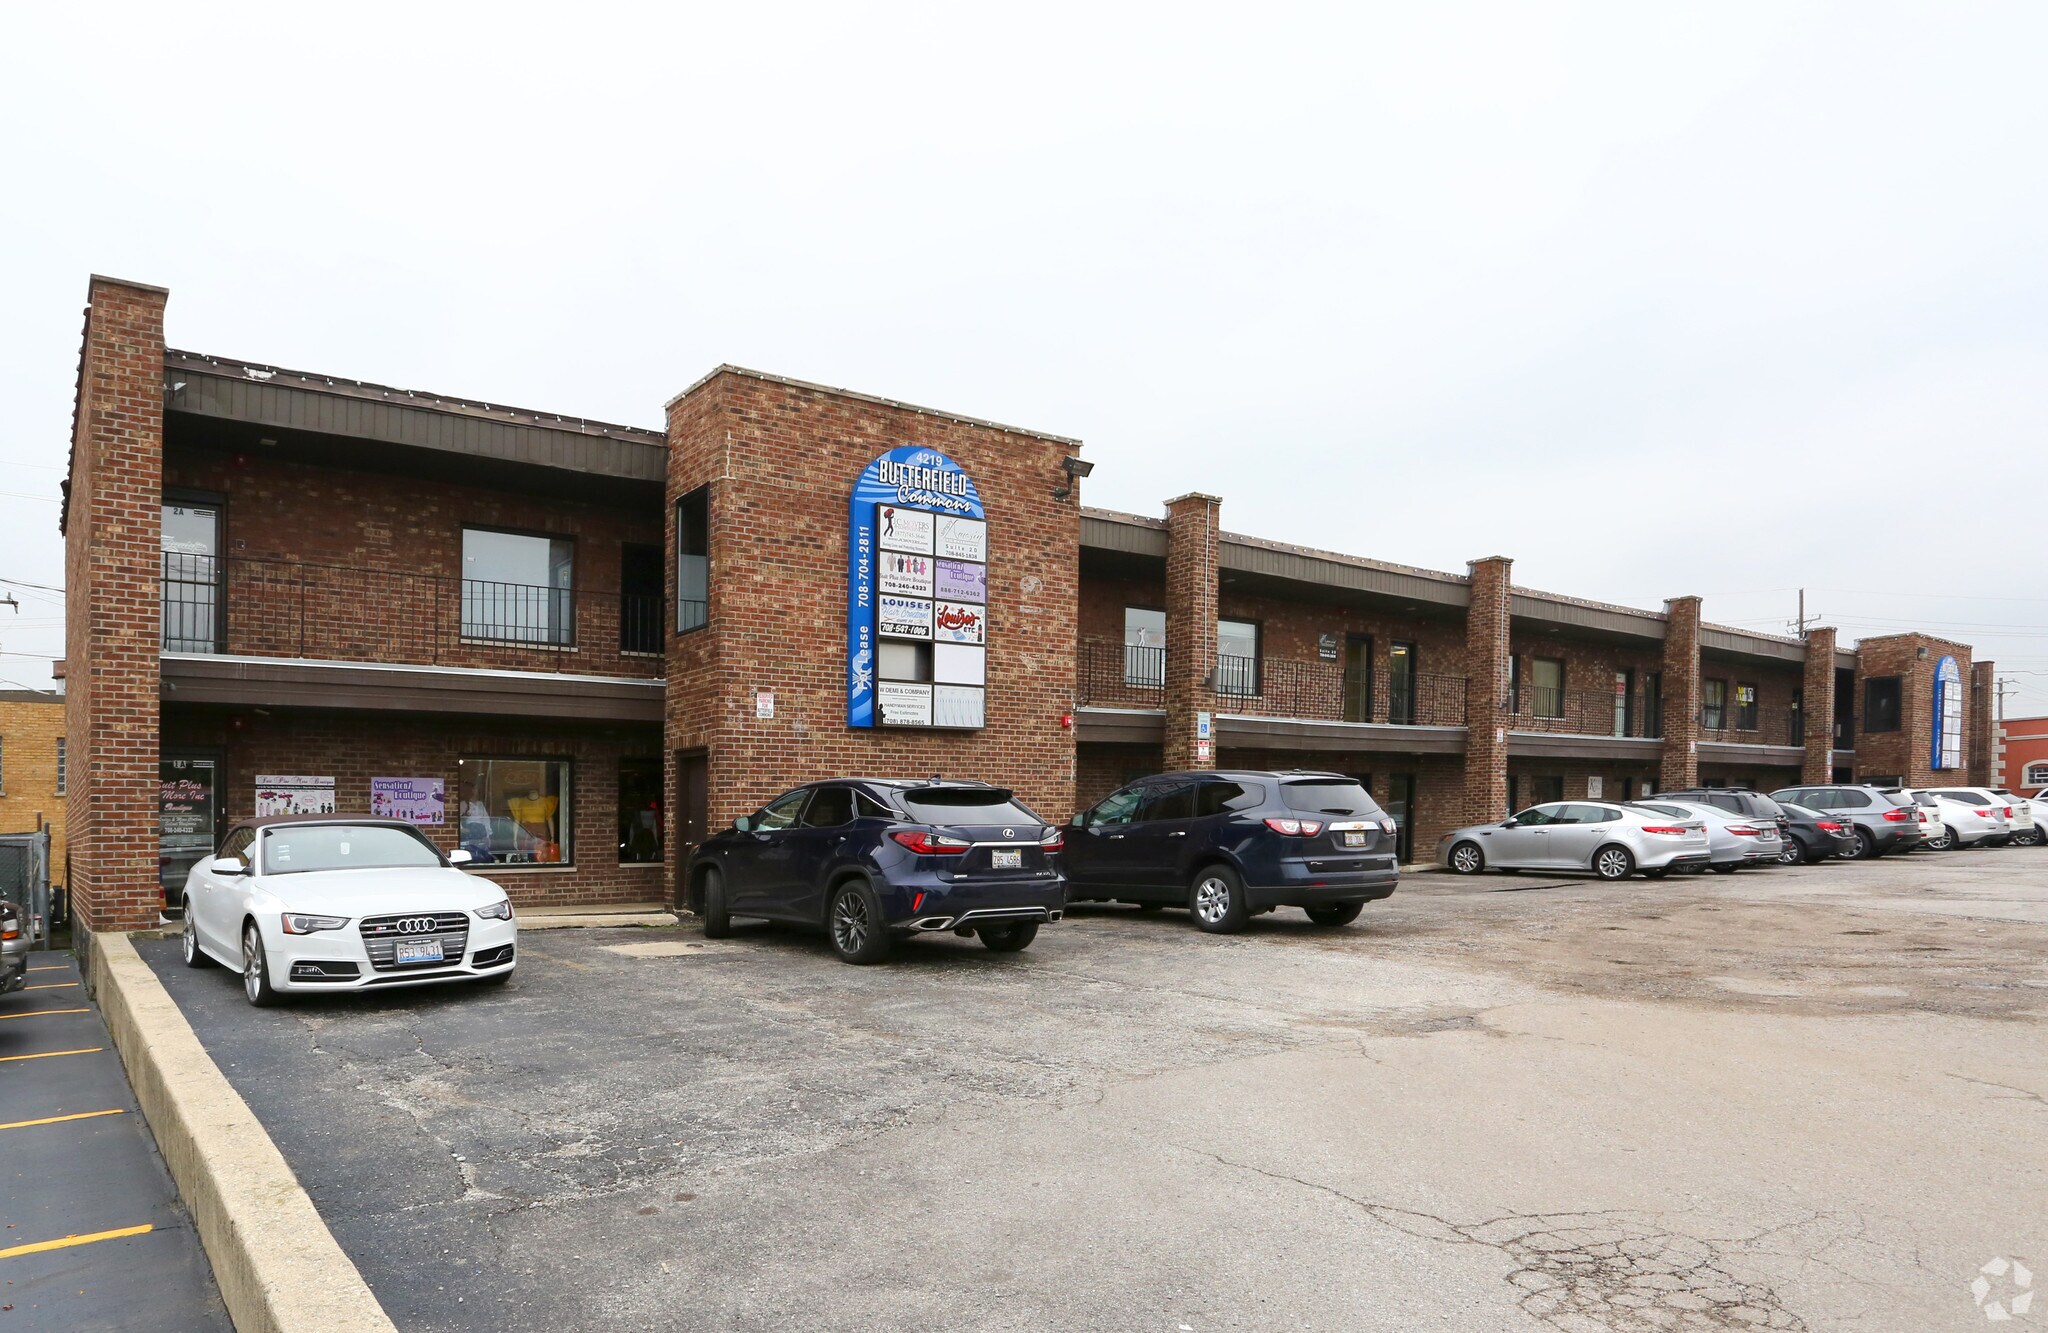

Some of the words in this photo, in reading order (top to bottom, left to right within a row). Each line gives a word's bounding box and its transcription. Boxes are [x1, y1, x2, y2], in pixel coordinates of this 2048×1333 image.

[916, 452, 942, 466] 4219
[879, 460, 967, 496] BUTTERFIELD
[898, 484, 972, 513] Commons
[173, 507, 184, 516] 2A
[858, 526, 869, 607] 708-704-2811
[884, 582, 926, 592] 708-240-4323
[912, 577, 931, 585] Boutique
[882, 598, 931, 610] LOUISES
[964, 626, 978, 634] ETC.
[858, 626, 868, 664] Lease
[857, 666, 868, 690] For
[904, 688, 930, 696] COMPANY
[179, 780, 202, 790] Plus
[162, 790, 186, 800] More
[190, 790, 204, 800] Inc
[400, 948, 414, 958] R53
[420, 946, 440, 957] 9431
